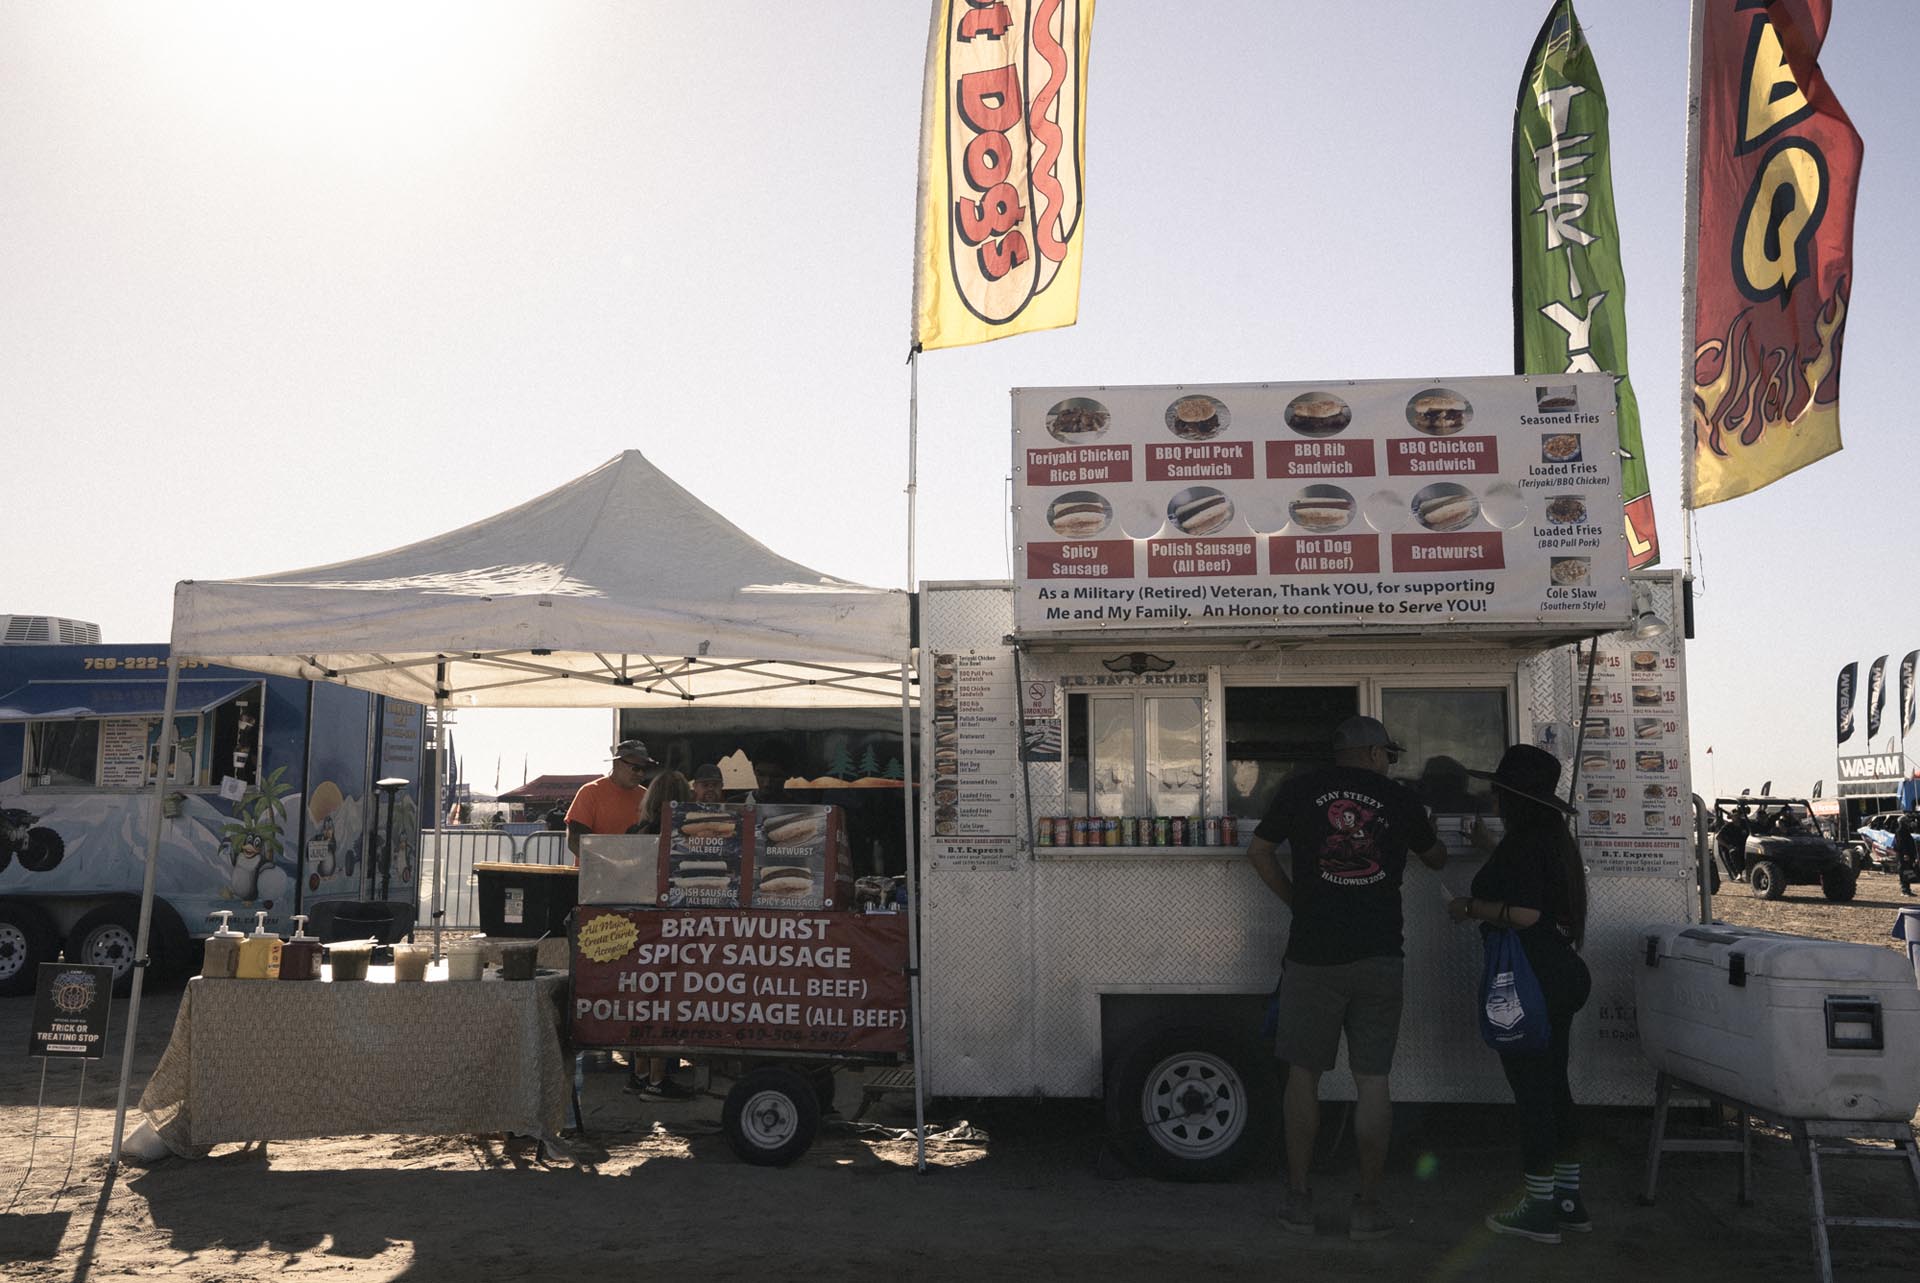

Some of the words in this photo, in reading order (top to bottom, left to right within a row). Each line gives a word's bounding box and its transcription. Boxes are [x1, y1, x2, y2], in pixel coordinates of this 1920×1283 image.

[956, 63, 1029, 282] Dogs
[1520, 414, 1571, 425] Seasoned
[1574, 413, 1600, 424] Fries
[1155, 447, 1182, 461] BBQ
[1184, 446, 1211, 459] Pull
[1212, 445, 1243, 459] Pork
[1294, 443, 1322, 457] BBQ
[1324, 443, 1345, 456] Rib
[1400, 441, 1426, 456] BBQ
[1429, 439, 1484, 454] Chicken
[1029, 450, 1077, 466] Teriyaki
[1079, 449, 1130, 463] Chicken
[1410, 458, 1476, 472] Sandwich
[1050, 468, 1078, 482] Rice
[1079, 466, 1109, 481] Bowl
[1168, 463, 1232, 478] Sandwich
[1288, 461, 1353, 475] Sandwich
[1529, 464, 1567, 476] Loaded
[1570, 463, 1598, 474] Fries
[1518, 477, 1574, 489] (Teriyaki/BBQ
[1576, 475, 1610, 488] Chicken)
[1533, 525, 1574, 537] Loaded
[1576, 524, 1602, 536] Fries
[1152, 542, 1192, 557] Polish
[1196, 541, 1251, 557] Sausage
[1296, 540, 1321, 554] Hot
[1324, 539, 1352, 555] Dog
[1538, 538, 1558, 549] (BBQ
[1560, 537, 1577, 549] Pull
[1578, 537, 1601, 549] Pork)
[1062, 545, 1098, 560] Spicy
[1412, 545, 1483, 560] Bratwurst
[1052, 562, 1109, 578] Sausage
[1173, 559, 1195, 574] (All
[1197, 558, 1231, 573] Beef)
[1295, 558, 1318, 572] (All
[1319, 557, 1354, 571] Beef)
[1038, 587, 1057, 601] As
[1061, 589, 1069, 600] a
[1074, 586, 1135, 602] Military
[1138, 585, 1207, 601] (Retired)
[1210, 585, 1277, 601] Veteran,
[1280, 583, 1330, 597] Thank
[1333, 583, 1373, 597] YOU,
[1376, 581, 1401, 594] for
[1404, 579, 1495, 596] supporting
[1546, 588, 1568, 599] Cole
[1570, 587, 1597, 599] Slaw
[1047, 607, 1069, 620] Me
[1073, 605, 1103, 619] and
[1107, 606, 1132, 622] My
[1136, 604, 1192, 622] Family.
[1202, 604, 1225, 617] An
[1229, 603, 1281, 617] Honor
[1283, 603, 1301, 615] to
[1303, 602, 1374, 615] continue
[1378, 601, 1395, 614] to
[1398, 600, 1442, 613] Serve
[1447, 598, 1487, 612] YOU!
[1540, 601, 1580, 612] (Southern
[1582, 599, 1606, 612] Style)
[1097, 675, 1135, 685] NAVY
[1145, 673, 1208, 684] RETIRED
[1032, 700, 1042, 708] NO
[1839, 755, 1900, 778] WABAM
[1315, 791, 1340, 807] STAY
[1343, 791, 1384, 809] STEEZY
[688, 837, 704, 846] HOT
[706, 837, 723, 846] DOG
[766, 847, 814, 856] BRATWURST
[966, 846, 1004, 856] Express
[1623, 851, 1664, 860] Express
[669, 887, 699, 897] POLISH
[700, 887, 737, 898] SAUSAGE
[756, 897, 780, 906] SPICY
[780, 898, 818, 907] SAUSAGE
[661, 915, 830, 940] BRATWURST
[638, 943, 717, 965] SPICY
[722, 944, 850, 968] SAUSAGE
[618, 971, 678, 993] HOT
[683, 971, 747, 994] DOG
[752, 976, 801, 997] (ALL
[807, 978, 867, 1000] BEEF)
[576, 998, 671, 1022] POLISH
[677, 1000, 800, 1026] SAUSAGE
[806, 1006, 848, 1027] (ALL
[853, 1008, 906, 1030] BEEF)
[51, 1023, 75, 1033] TRICK
[76, 1024, 88, 1034] OR
[37, 1031, 77, 1042] TREATING
[78, 1033, 100, 1043] STOP
